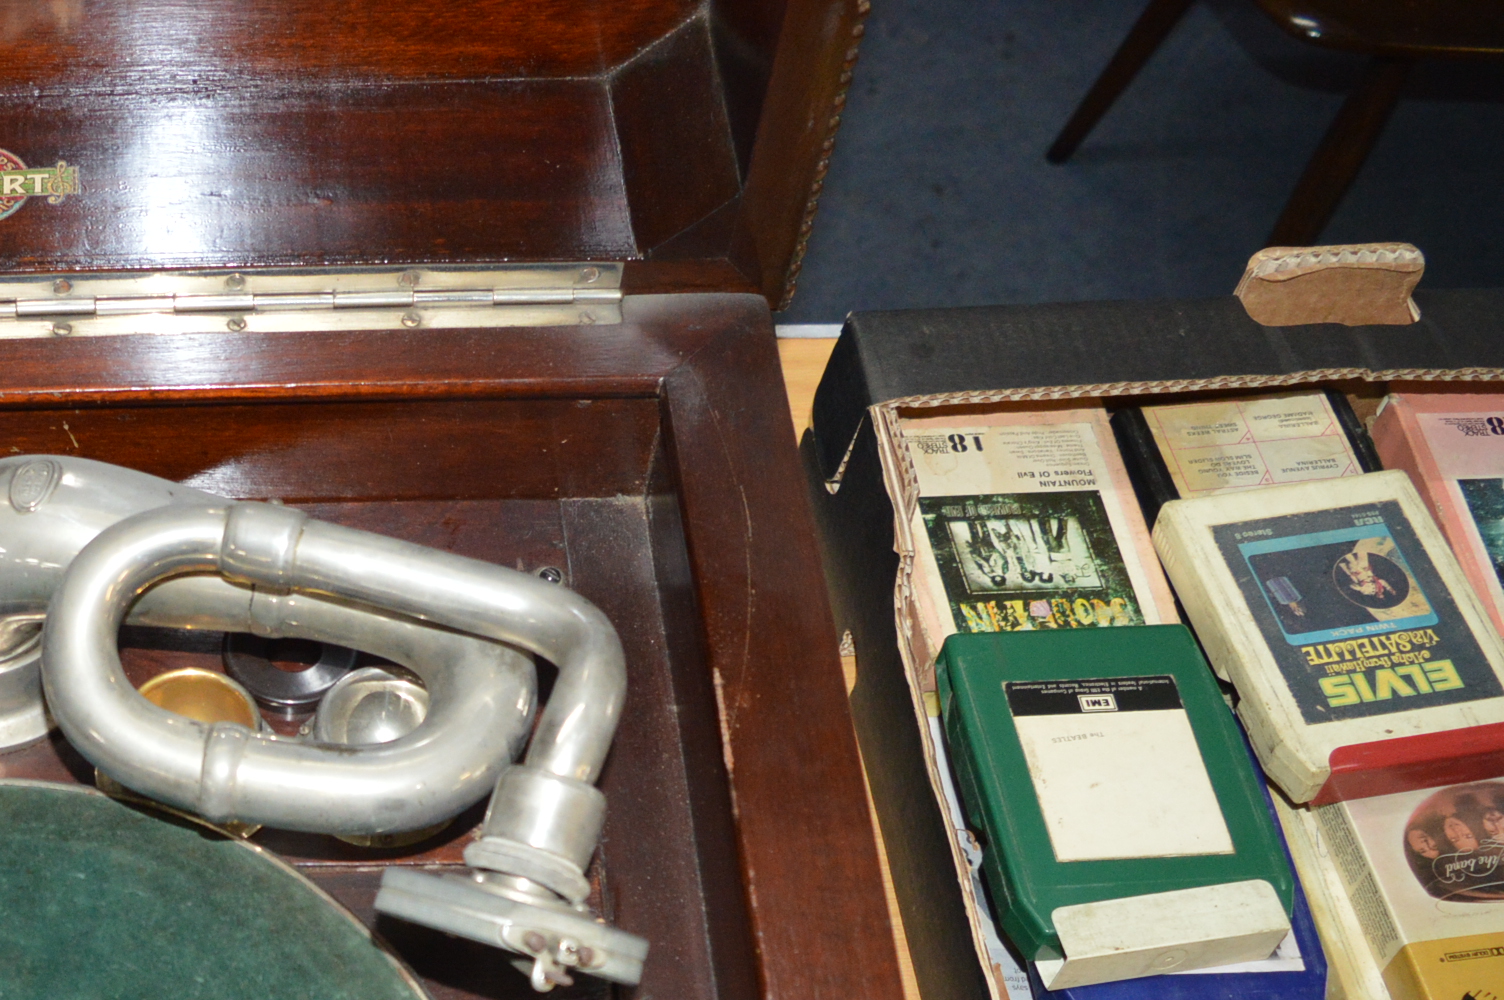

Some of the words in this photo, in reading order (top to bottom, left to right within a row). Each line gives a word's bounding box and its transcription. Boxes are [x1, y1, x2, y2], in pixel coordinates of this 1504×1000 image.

[1054, 469, 1093, 477] Flowers
[1039, 479, 1096, 487] MOUNTAIN
[1353, 515, 1384, 526] RCA
[1242, 527, 1273, 537] Stereo
[1330, 624, 1369, 637] PACK
[1372, 621, 1397, 630] TWIN
[1301, 632, 1412, 665] SATELLITE
[1363, 654, 1391, 669] from
[1390, 649, 1431, 664] Aloha
[1325, 660, 1366, 675] Hawaii
[1318, 659, 1465, 707] ELVIS
[1085, 698, 1110, 707] EMI
[1051, 733, 1087, 743] BEATLES
[1445, 859, 1475, 877] band
[1478, 856, 1497, 869] the
